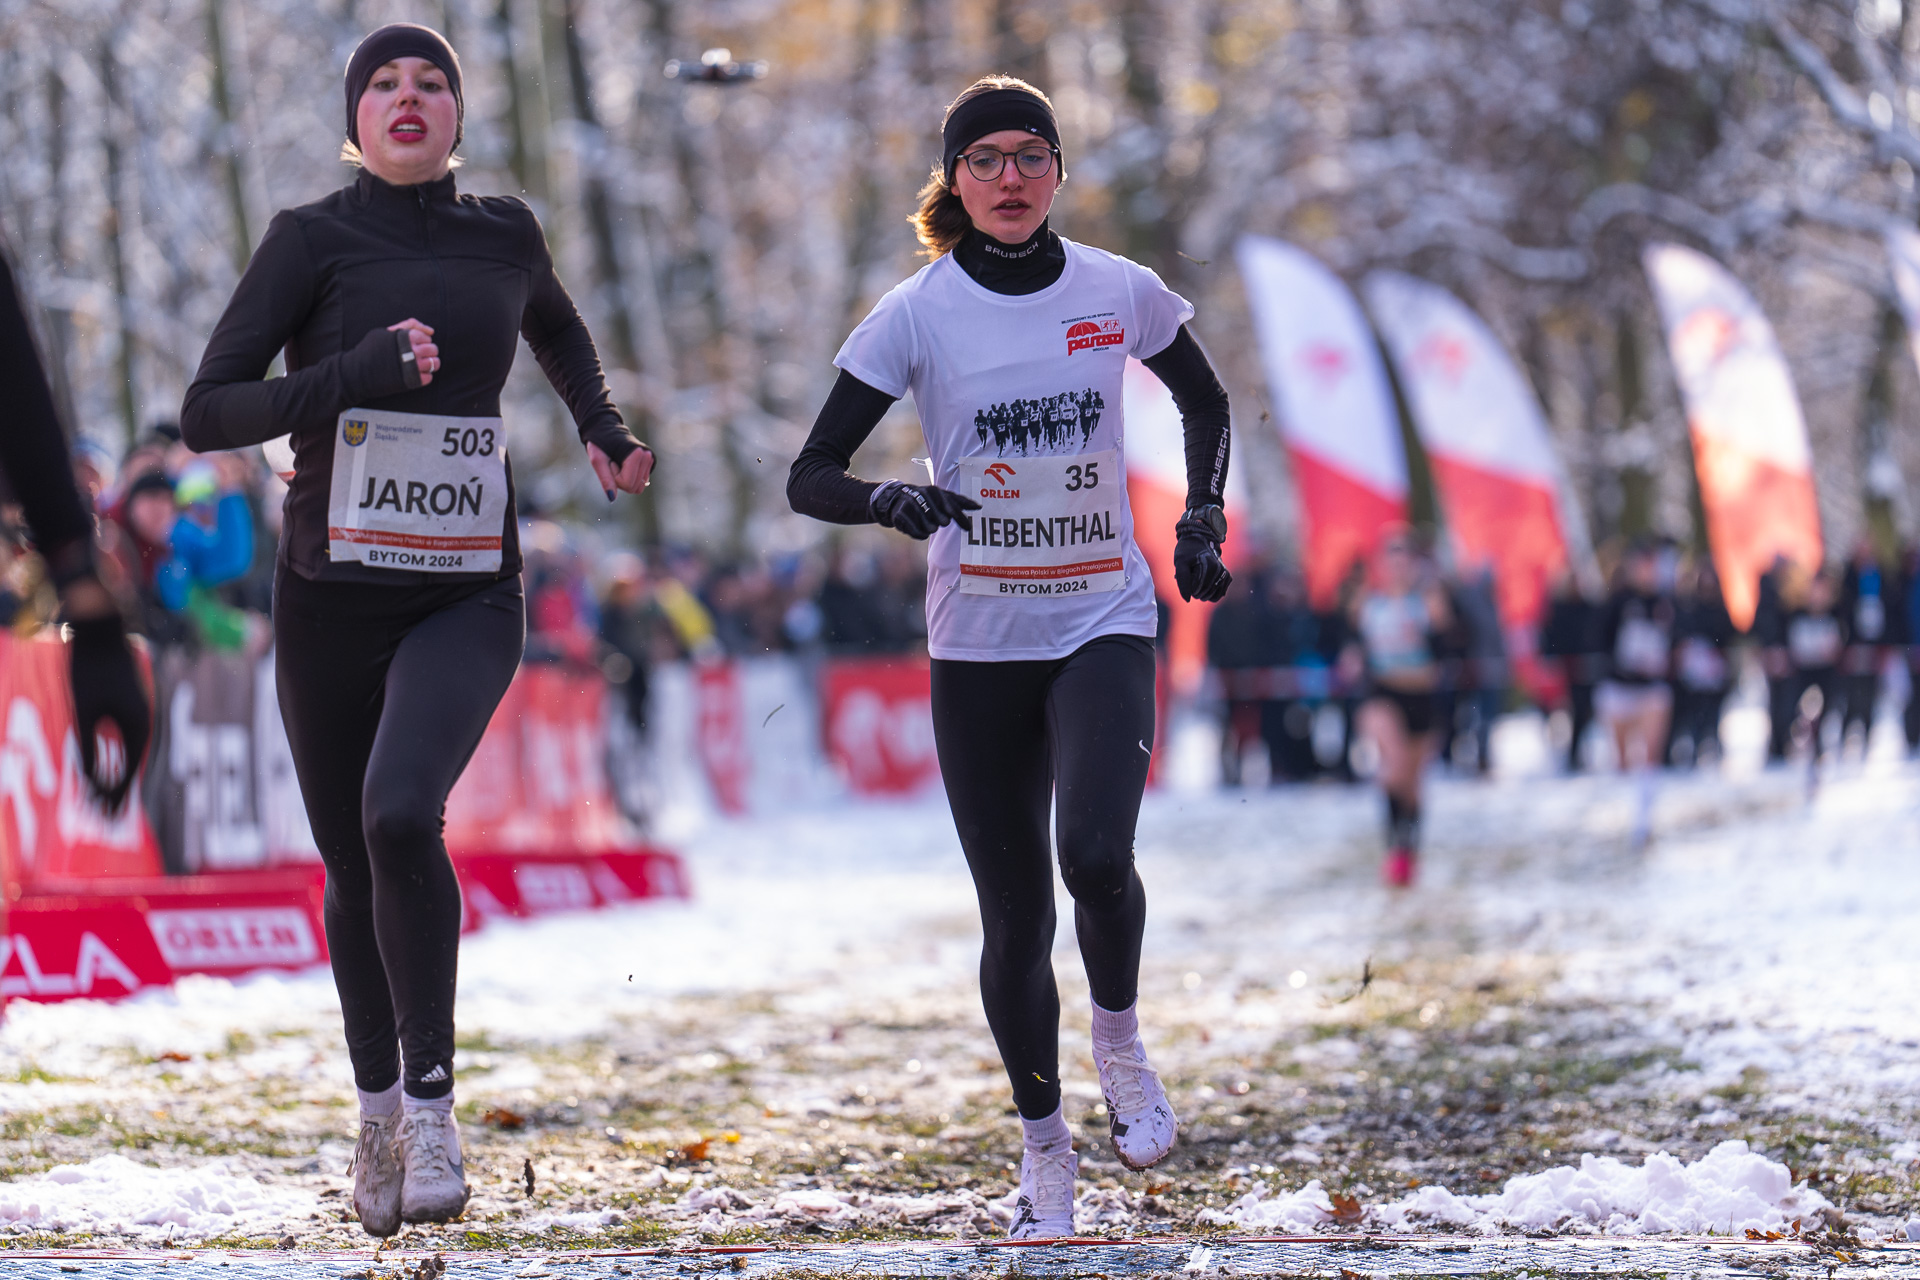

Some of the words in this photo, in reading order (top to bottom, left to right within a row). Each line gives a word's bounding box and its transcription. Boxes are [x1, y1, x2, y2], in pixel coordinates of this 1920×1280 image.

[441, 427, 495, 457] 503
[1065, 462, 1099, 491] 35
[359, 476, 483, 516] JAROŃ
[980, 488, 1020, 499] ORLEN
[967, 511, 1116, 548] LIEBENTHAL
[369, 550, 425, 566] BYTOM
[428, 555, 463, 567] 2024
[1057, 566, 1081, 575] Biegach
[999, 583, 1051, 594] BYTOM
[1055, 580, 1088, 594] 2024
